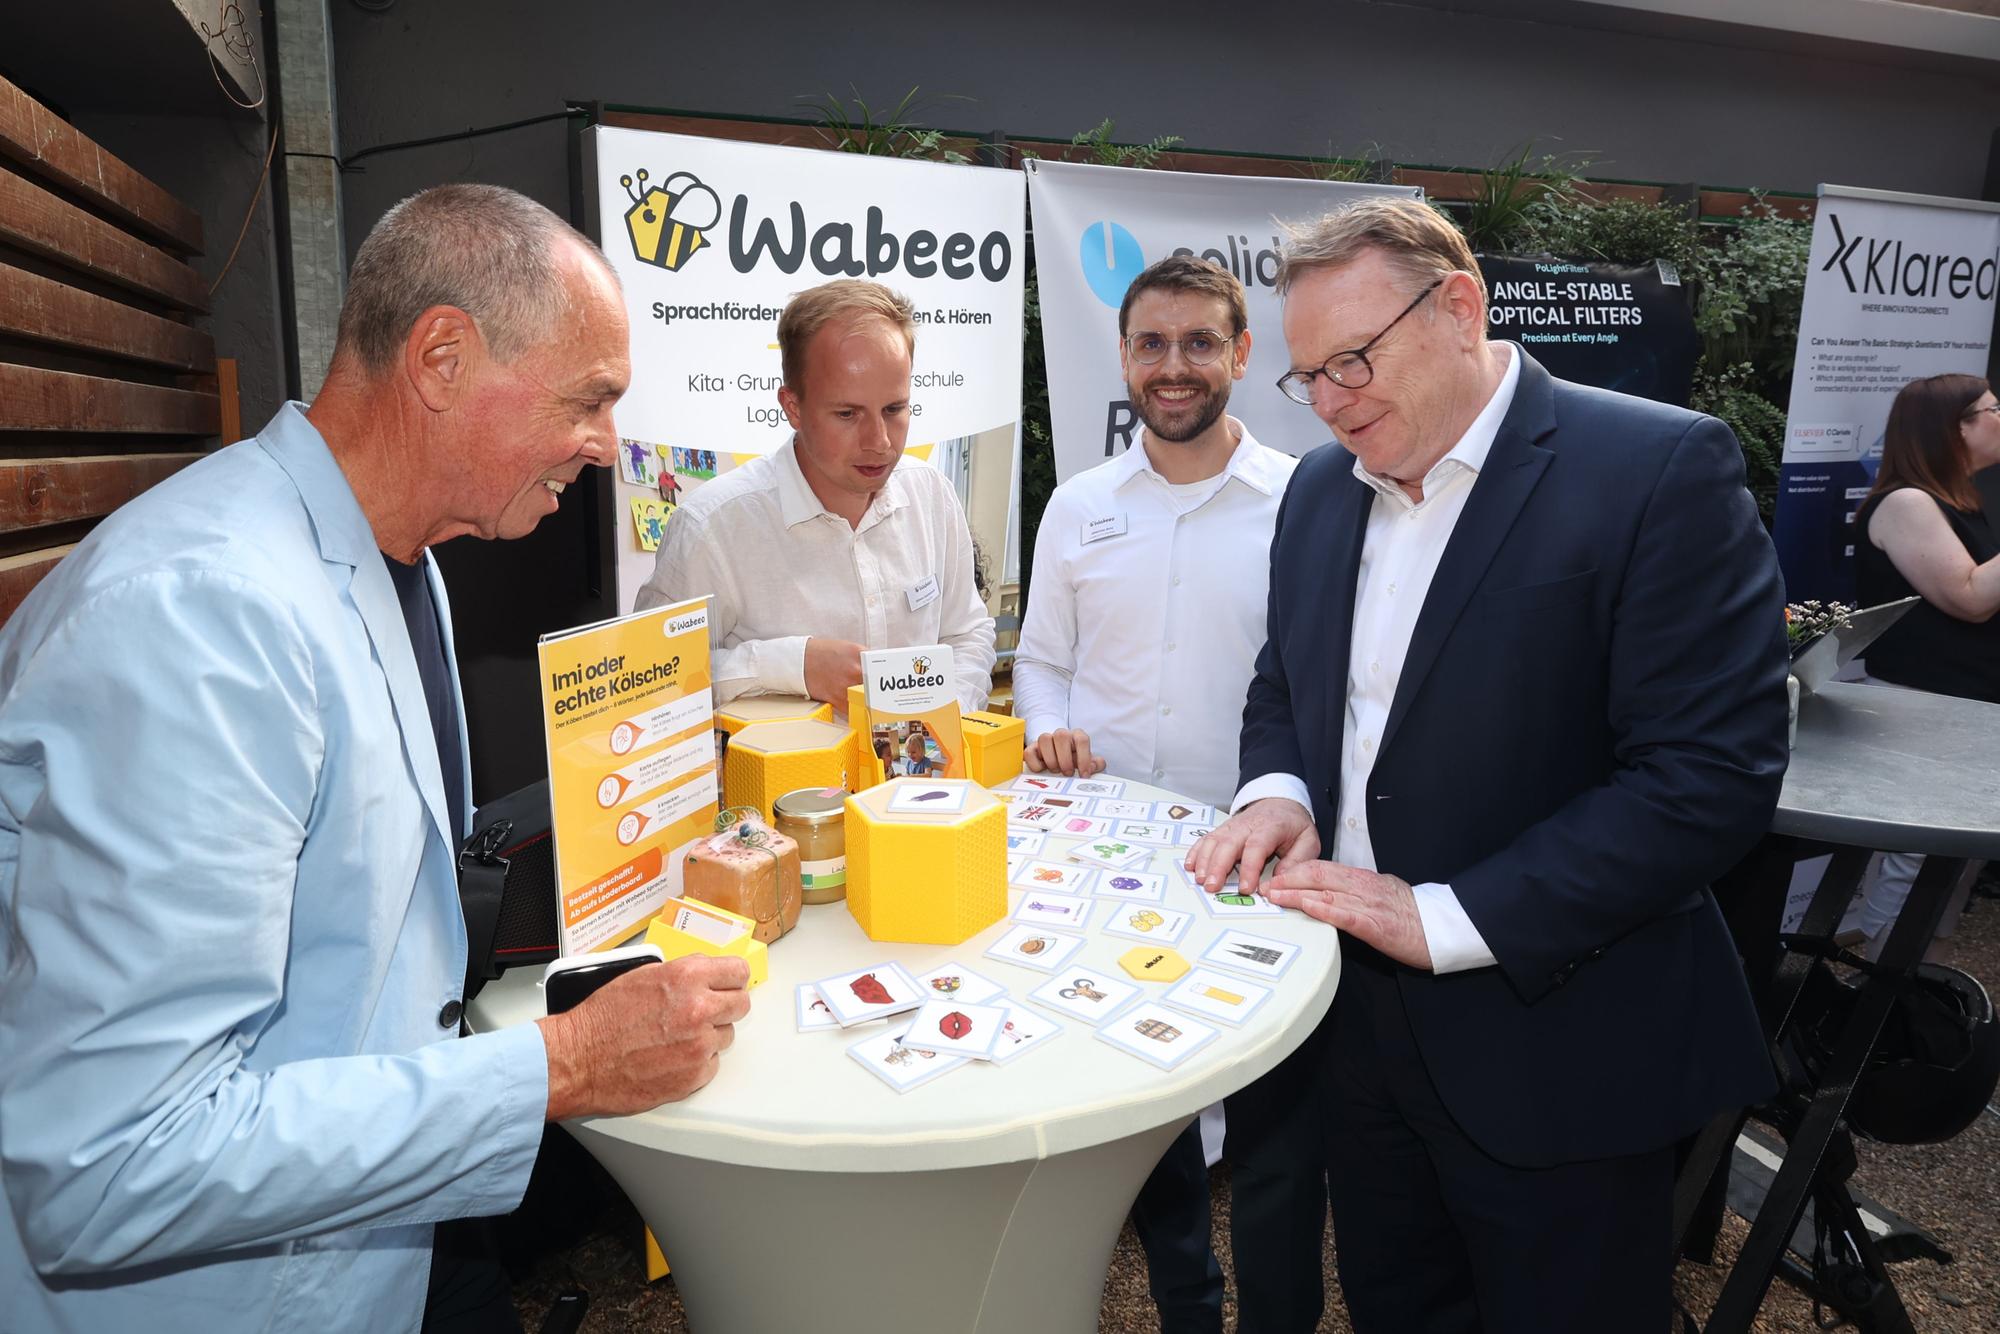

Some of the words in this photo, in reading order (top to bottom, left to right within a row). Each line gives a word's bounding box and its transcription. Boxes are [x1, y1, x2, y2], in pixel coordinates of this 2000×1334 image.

[728, 193, 1012, 283] Wabeeo
[1535, 263, 1590, 275] PoLightFilters
[1493, 281, 1634, 301] ANGLE-STABLE
[652, 301, 783, 325] Sprachförder
[934, 308, 946, 324] &
[948, 308, 992, 325] Hören
[1489, 305, 1571, 325] OPTICAL
[1574, 306, 1643, 325] FILTERS
[1862, 303, 1881, 313] WHERE
[1882, 304, 1918, 315] INNOVATION
[1918, 305, 1950, 316] CONNECTS
[1521, 332, 1561, 343] Precision
[1562, 333, 1571, 343] at
[1572, 332, 1596, 345] Every
[1597, 332, 1619, 345] Angle
[1811, 337, 1825, 346] Can
[1826, 338, 1838, 346] You
[1839, 338, 1860, 346] Answer
[1861, 338, 1871, 346] The
[1872, 339, 1888, 347] Basic
[1889, 340, 1914, 349] Strategic
[1915, 340, 1942, 349] Questions
[688, 373, 724, 392] Kita
[737, 373, 784, 391] Grun
[677, 615, 706, 631] Wabeeo
[552, 663, 582, 692] Imi
[585, 655, 626, 681] oder
[879, 673, 945, 692] Wabeeo
[554, 686, 606, 715] echte
[608, 656, 680, 697] Kölsche?
[568, 884, 598, 908] Bestzeit
[598, 865, 634, 894] geschafft?
[570, 908, 581, 920] Ab
[581, 900, 598, 913] aufs
[598, 872, 643, 904] Leaderboard!
[571, 927, 580, 937] So
[579, 917, 598, 931] lernen
[597, 907, 615, 922] Kinder
[615, 901, 625, 911] mit
